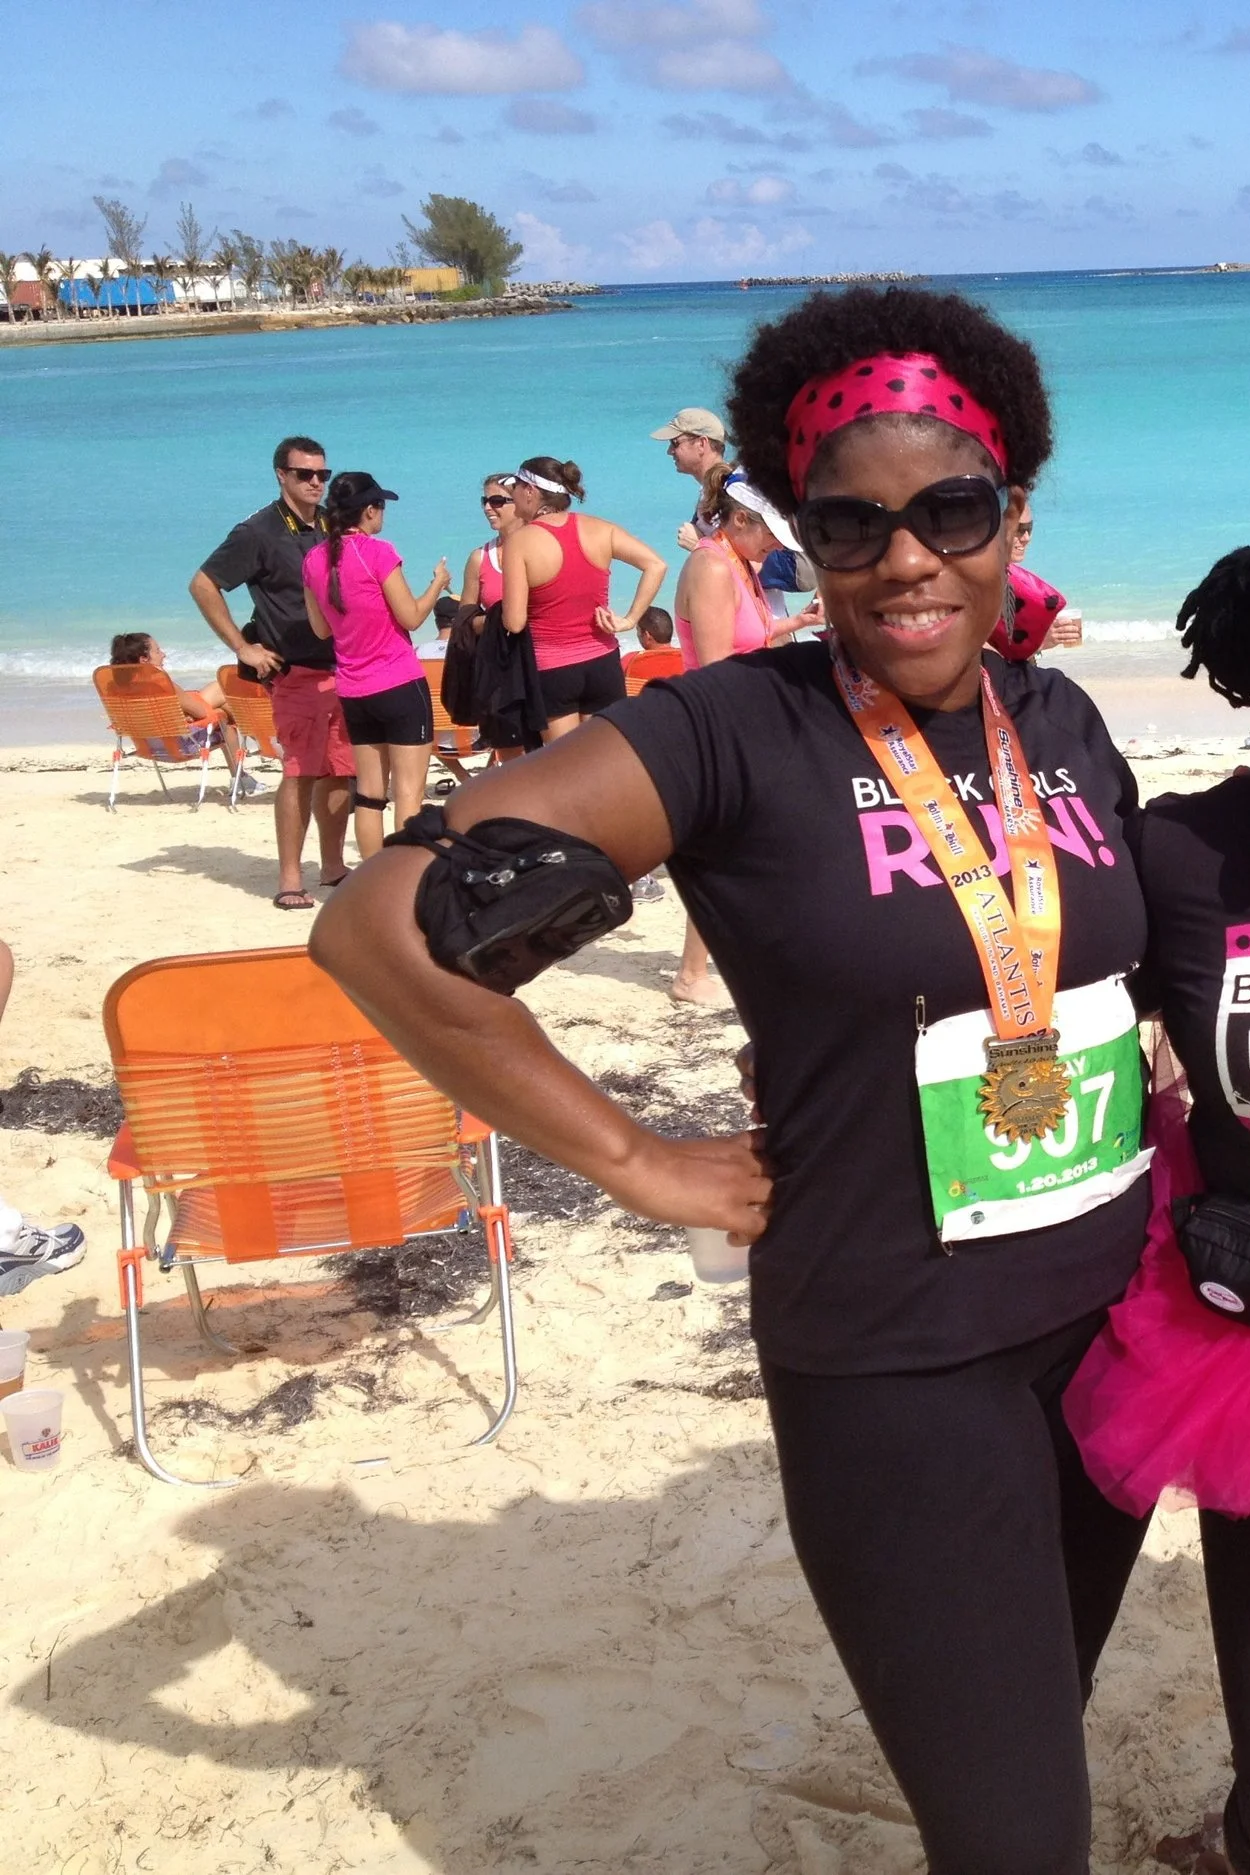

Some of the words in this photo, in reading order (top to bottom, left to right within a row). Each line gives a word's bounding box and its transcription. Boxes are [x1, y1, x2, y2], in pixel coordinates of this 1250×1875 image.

[888, 741, 910, 775] Assurance
[896, 737, 917, 771] RoyalStar
[999, 729, 1023, 808] Sunshine
[852, 773, 983, 809] BLK
[923, 800, 943, 824] John
[944, 832, 964, 855] Bull
[951, 865, 992, 888] 2013
[1028, 876, 1036, 915] Assurance
[977, 892, 1036, 1026] ATLANTIS
[989, 1043, 1059, 1059] Sunshine
[1016, 1157, 1098, 1194] 1.20.2013
[32, 1437, 58, 1452] KALIK
